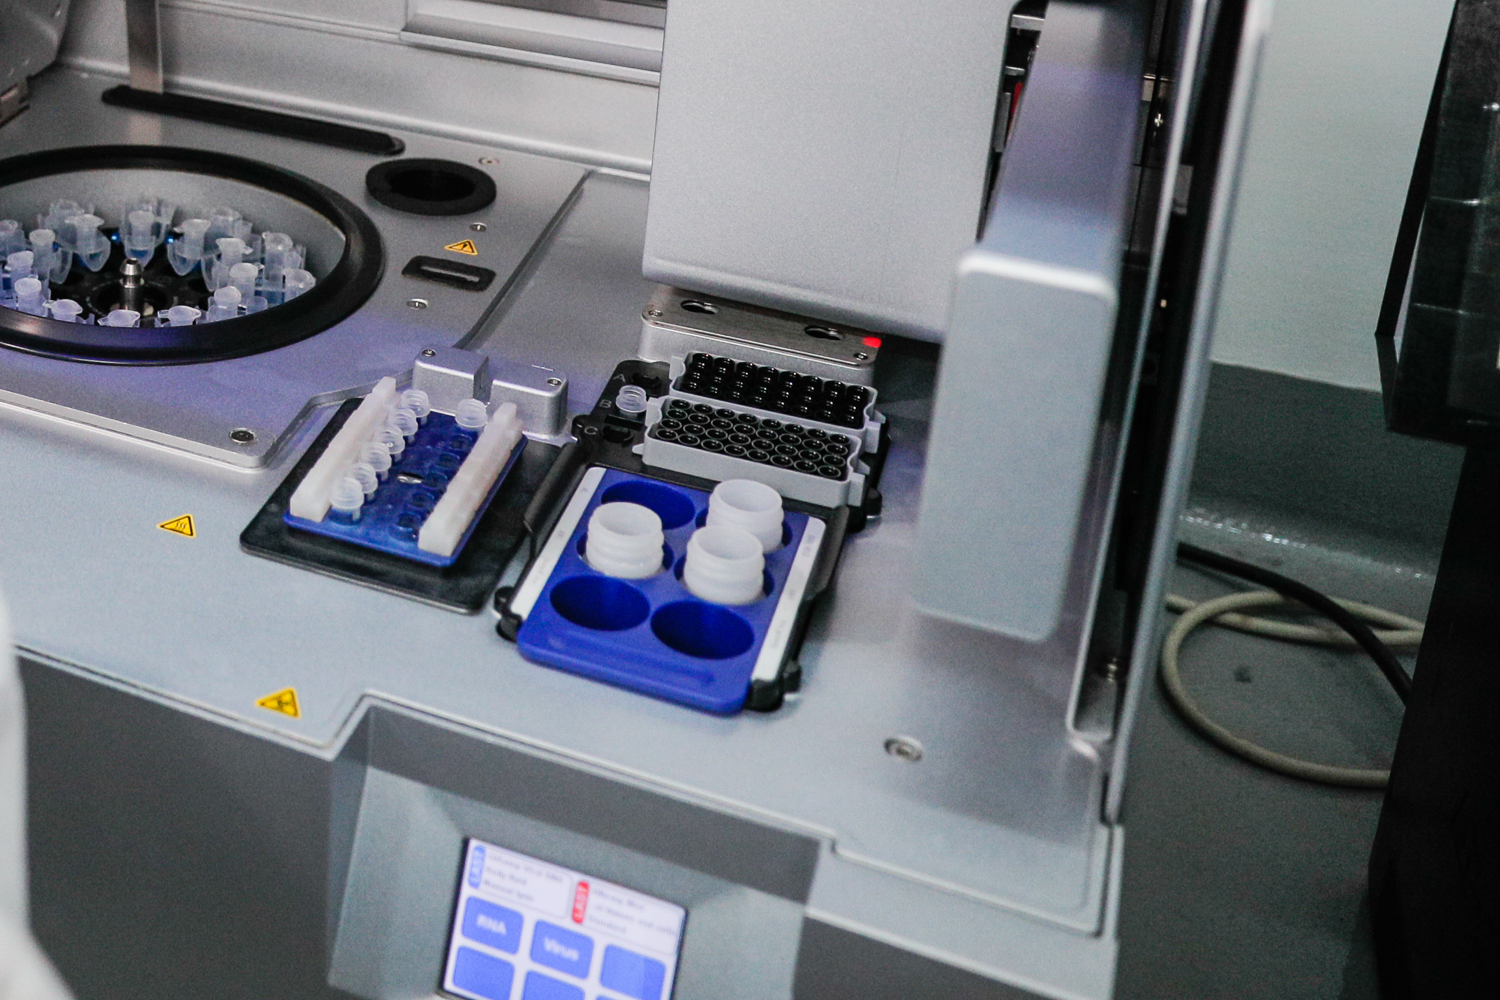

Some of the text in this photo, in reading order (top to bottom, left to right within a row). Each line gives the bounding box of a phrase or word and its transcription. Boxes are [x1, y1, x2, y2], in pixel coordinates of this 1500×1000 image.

[599, 399, 612, 409] B
[584, 426, 598, 434] C
[573, 883, 589, 920] LAST
[476, 913, 506, 935] RNA
[544, 937, 579, 961] Virus
